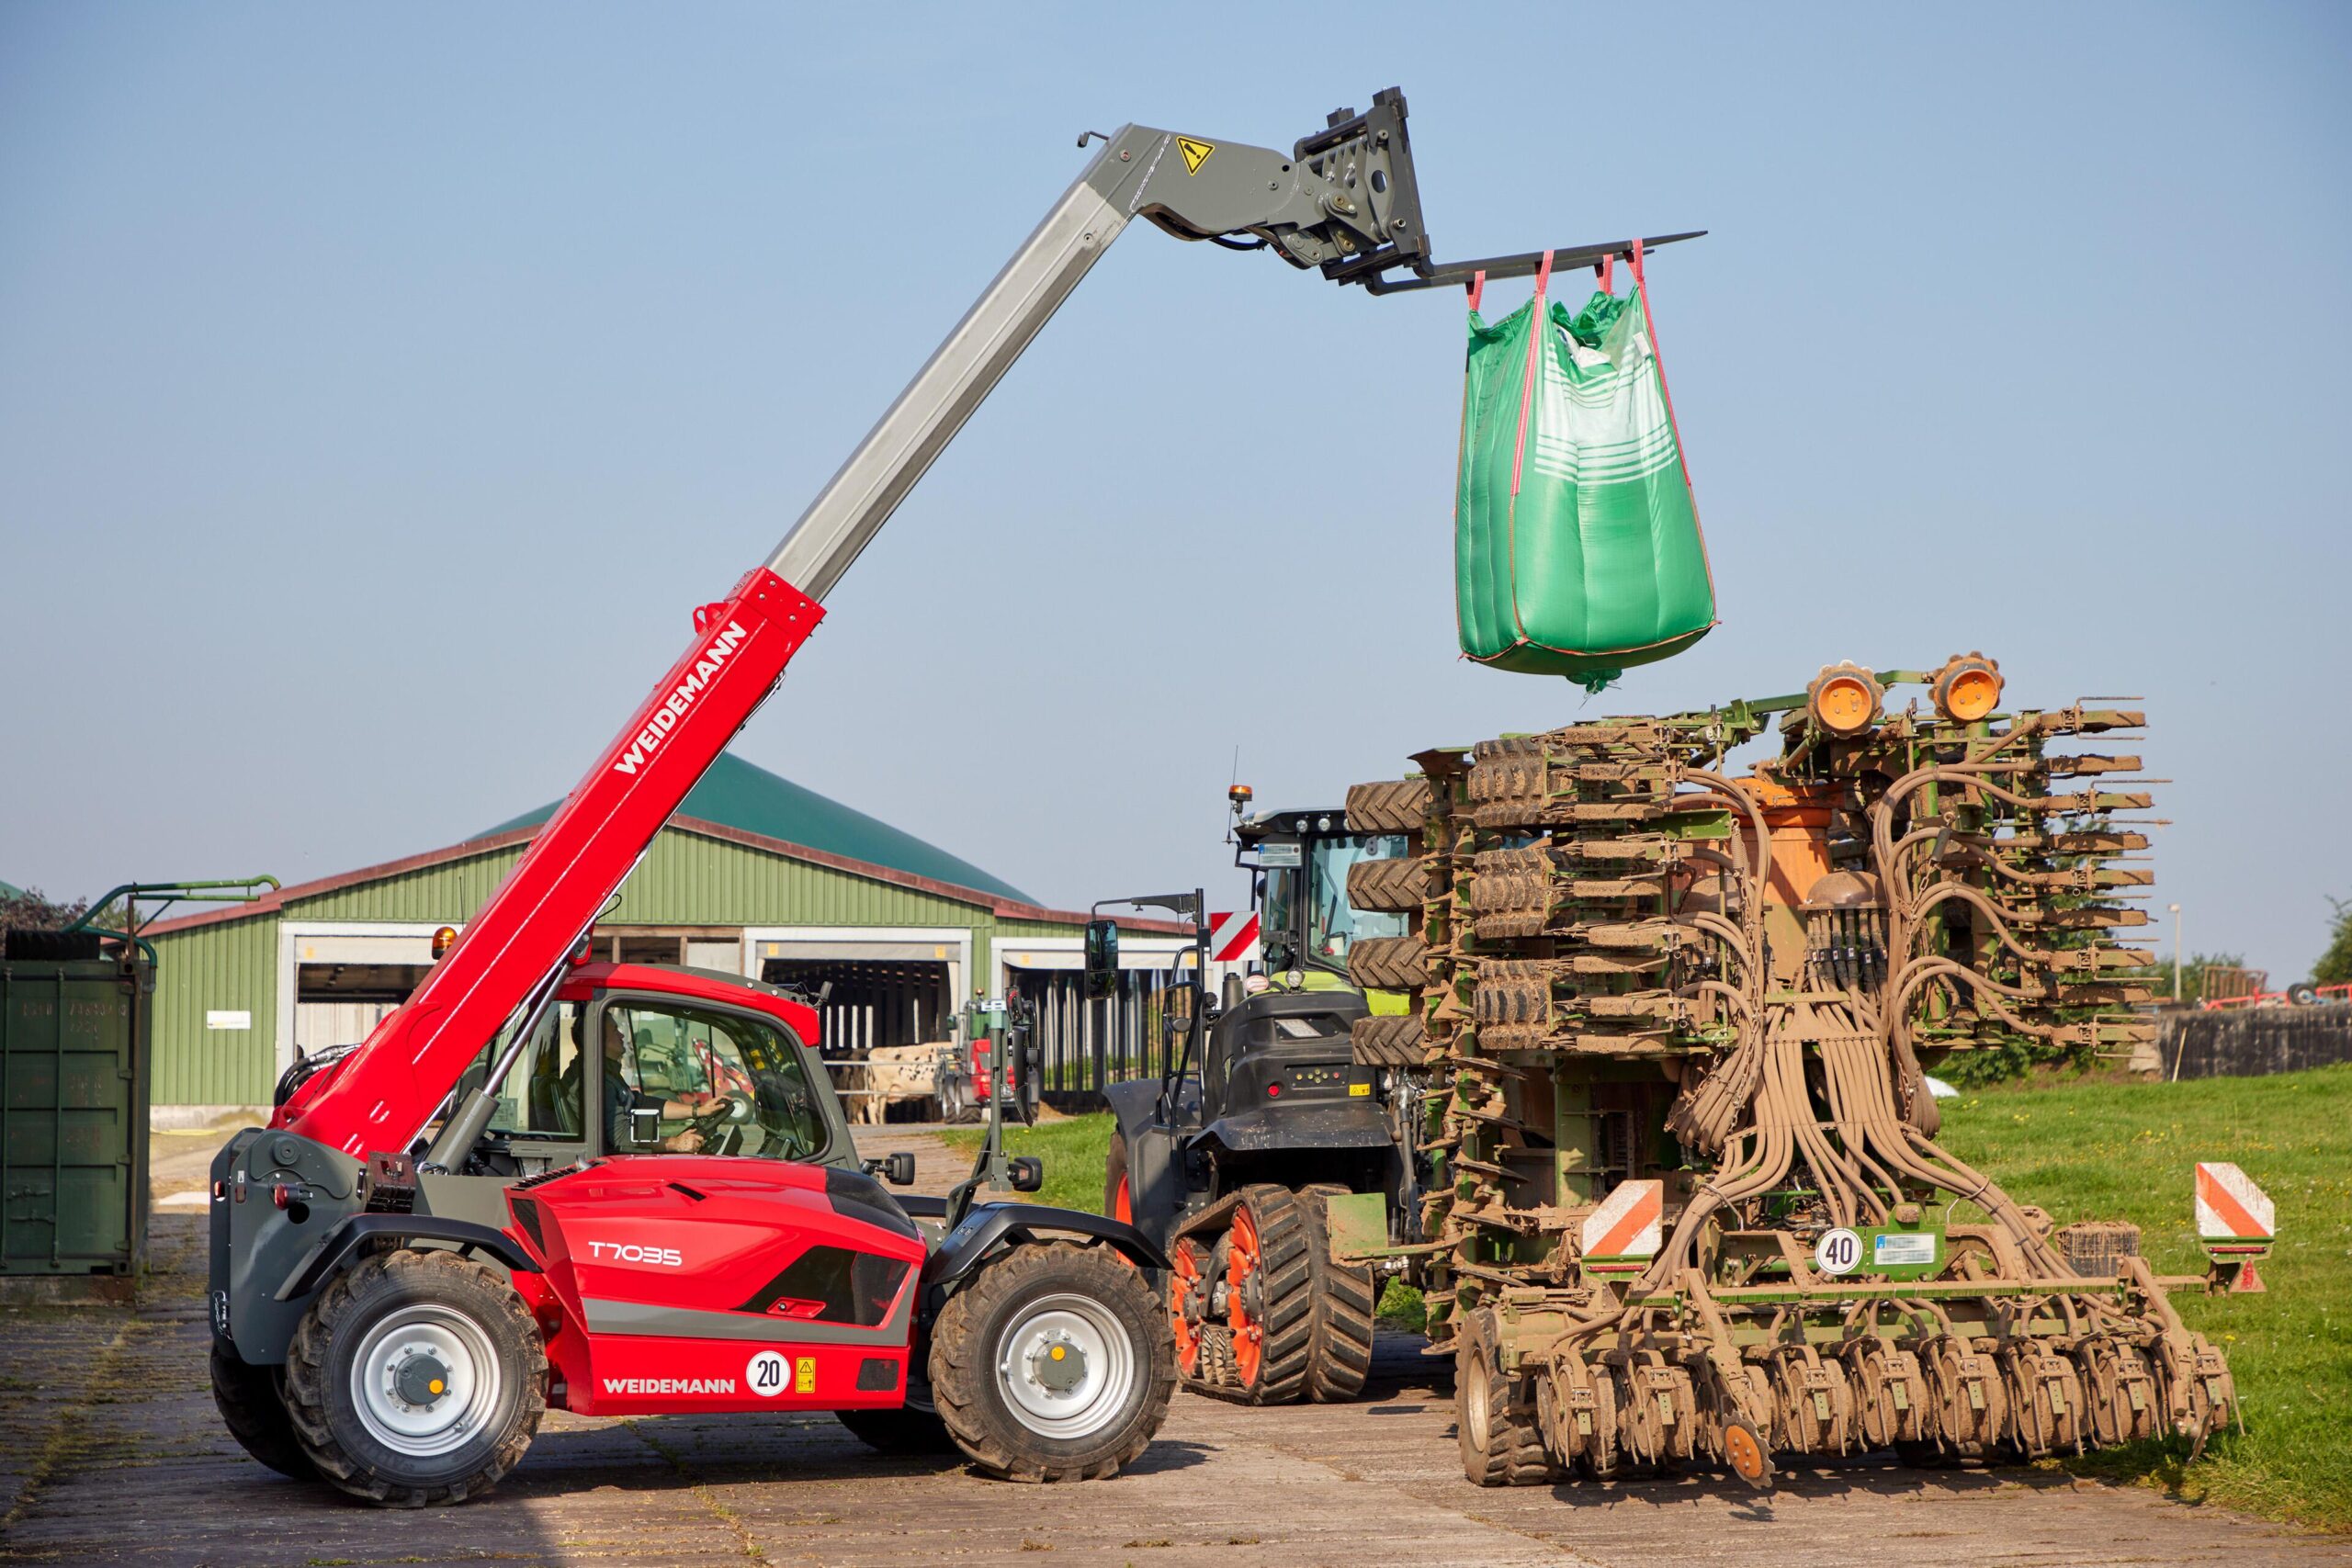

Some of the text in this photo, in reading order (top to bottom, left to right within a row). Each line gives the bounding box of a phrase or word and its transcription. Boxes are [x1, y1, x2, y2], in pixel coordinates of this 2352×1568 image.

[613, 620, 747, 774] WEIDEMANN
[589, 1241, 683, 1267] T7035
[1826, 1237, 1852, 1265] 40
[603, 1379, 735, 1394] WEIDEMANN
[757, 1359, 780, 1387] 20
